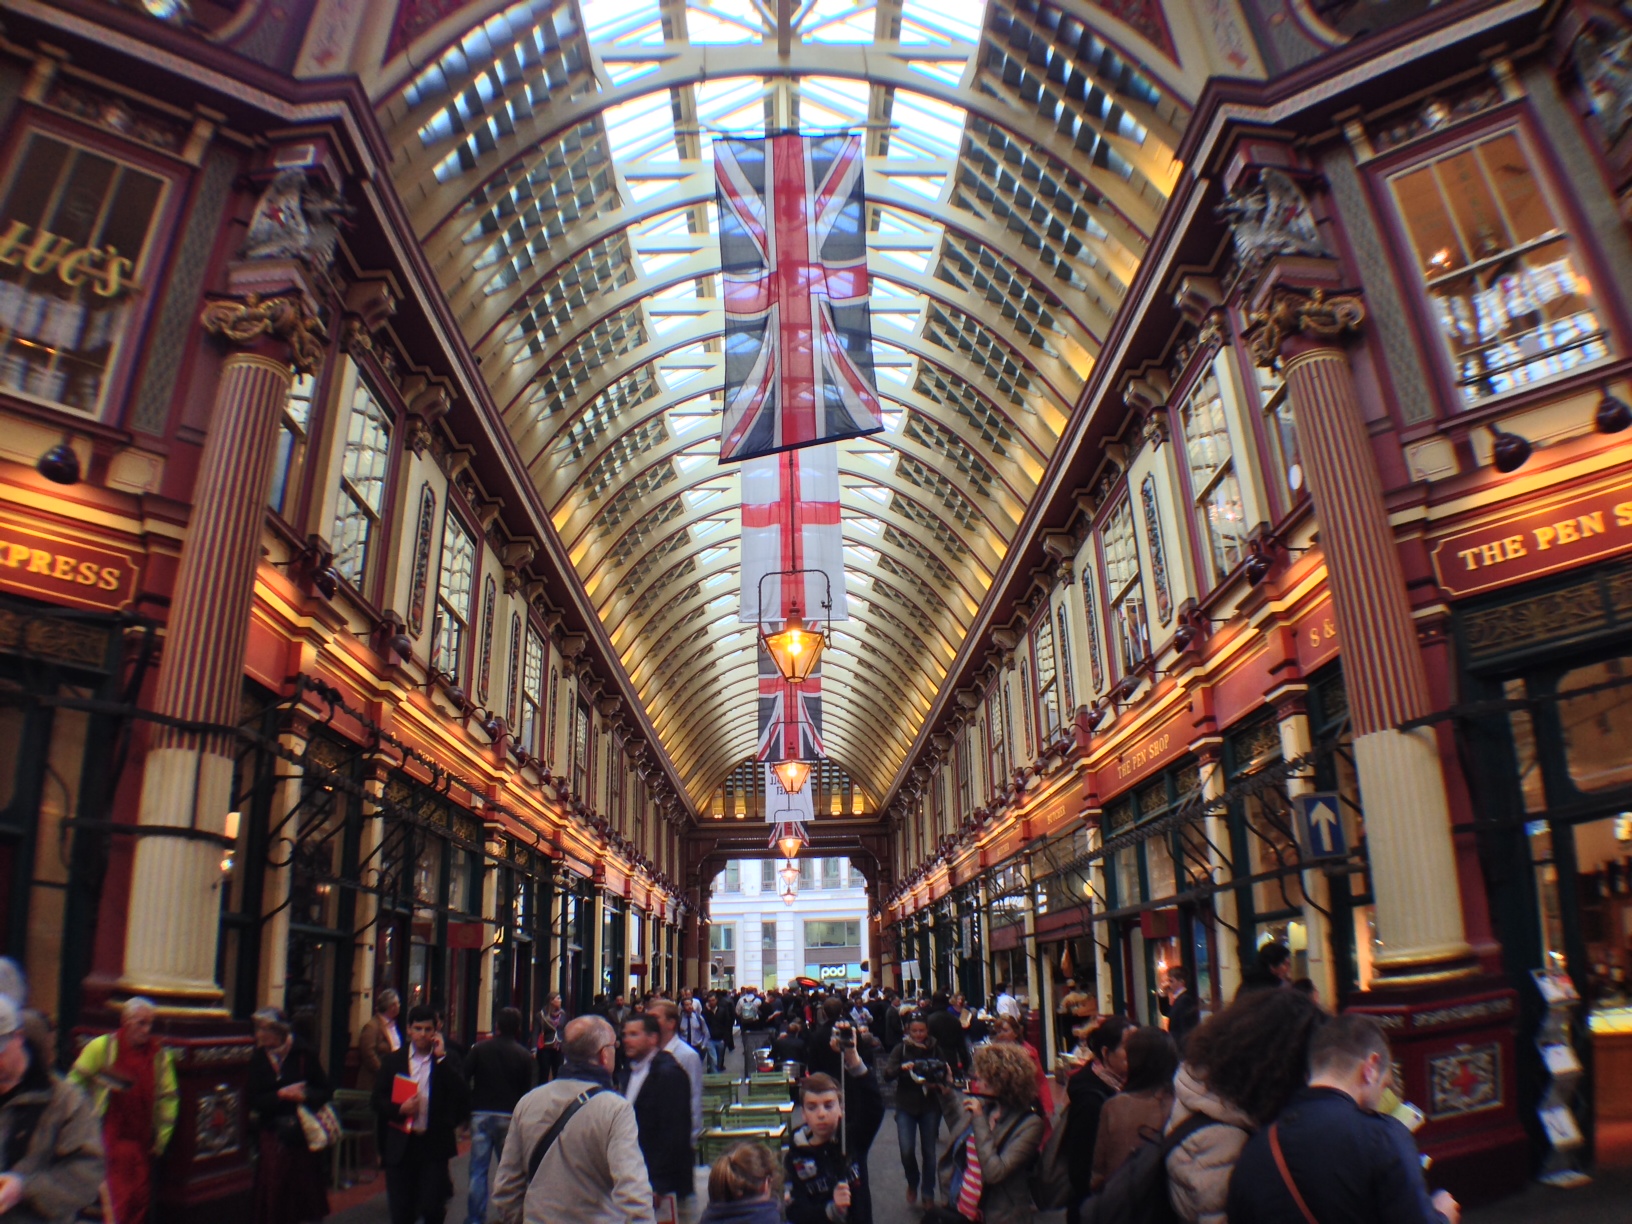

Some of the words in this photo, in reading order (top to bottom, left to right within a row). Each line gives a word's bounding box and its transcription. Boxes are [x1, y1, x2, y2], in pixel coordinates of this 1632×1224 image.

[1457, 534, 1528, 571] THE
[1532, 511, 1606, 551] PEN
[1323, 618, 1336, 639] &
[1117, 759, 1132, 780] THE
[1132, 748, 1147, 770] PEN
[1149, 733, 1170, 759] SHOP
[821, 963, 846, 980] pod
